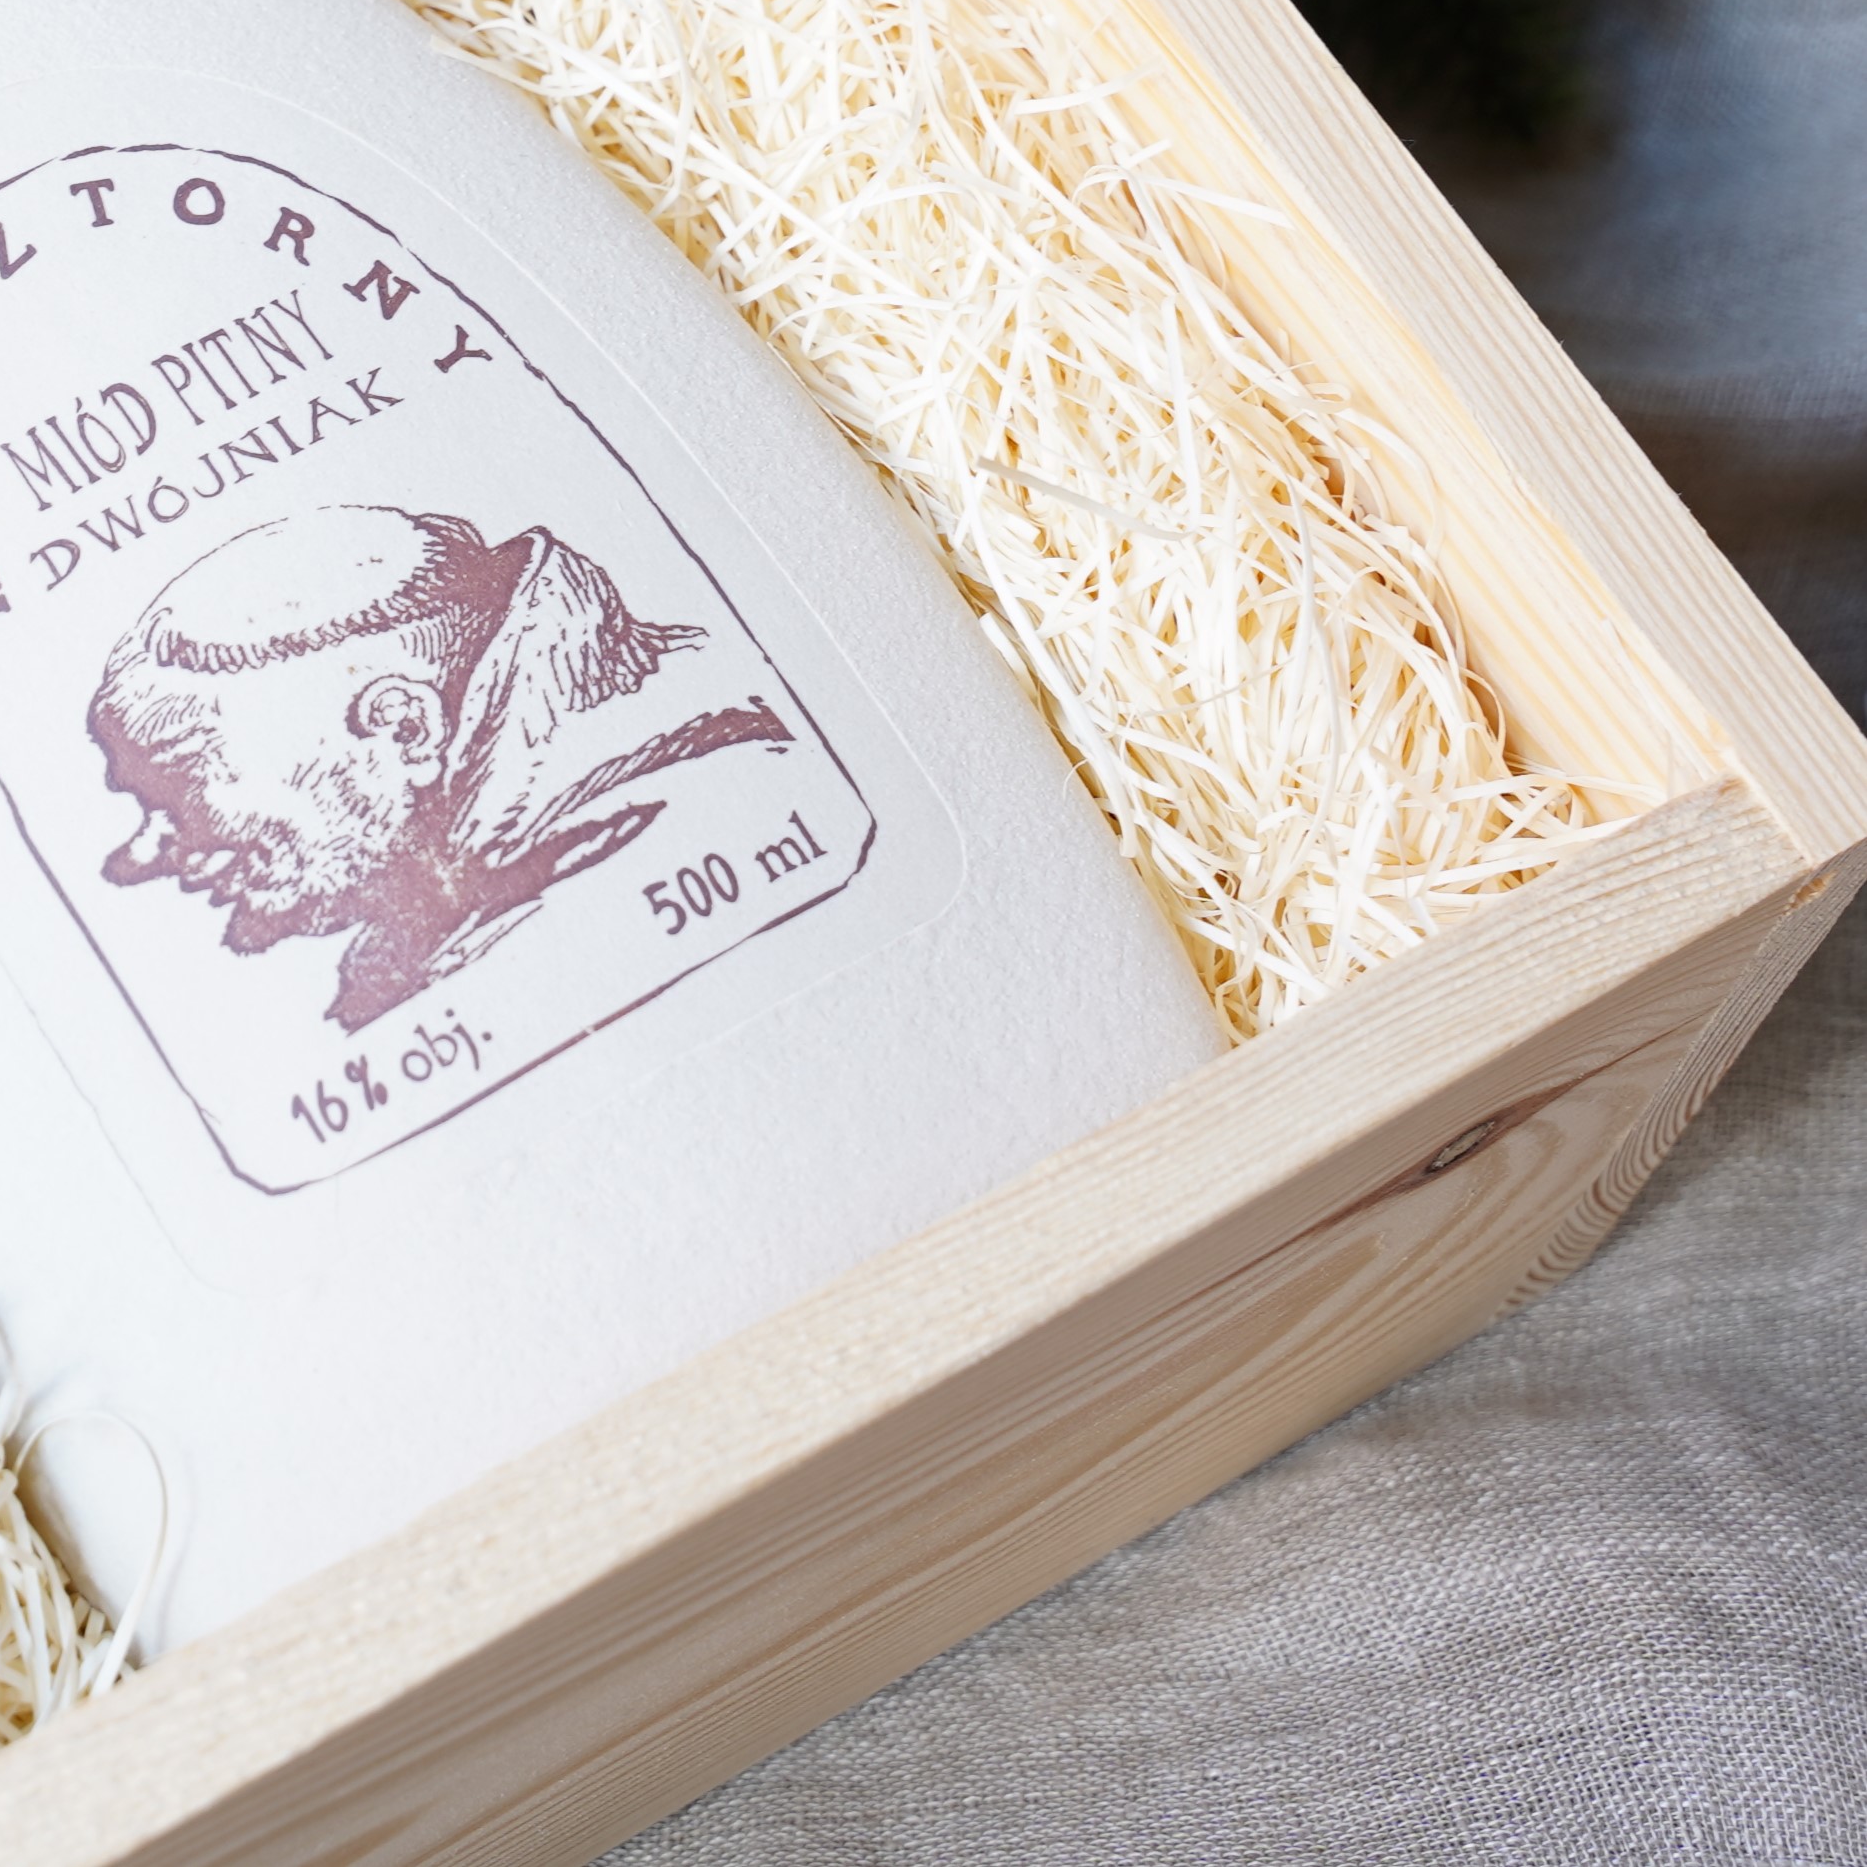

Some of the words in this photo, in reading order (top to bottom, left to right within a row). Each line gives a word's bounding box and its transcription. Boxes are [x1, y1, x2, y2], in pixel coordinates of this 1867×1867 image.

[0, 382, 157, 512] MIÓD
[151, 289, 335, 426] PITNY
[29, 366, 405, 592] DWÓJNIAK
[641, 852, 741, 936] 500
[754, 809, 829, 884] ml
[290, 1054, 389, 1144] 16%
[400, 1007, 494, 1082] obj.
